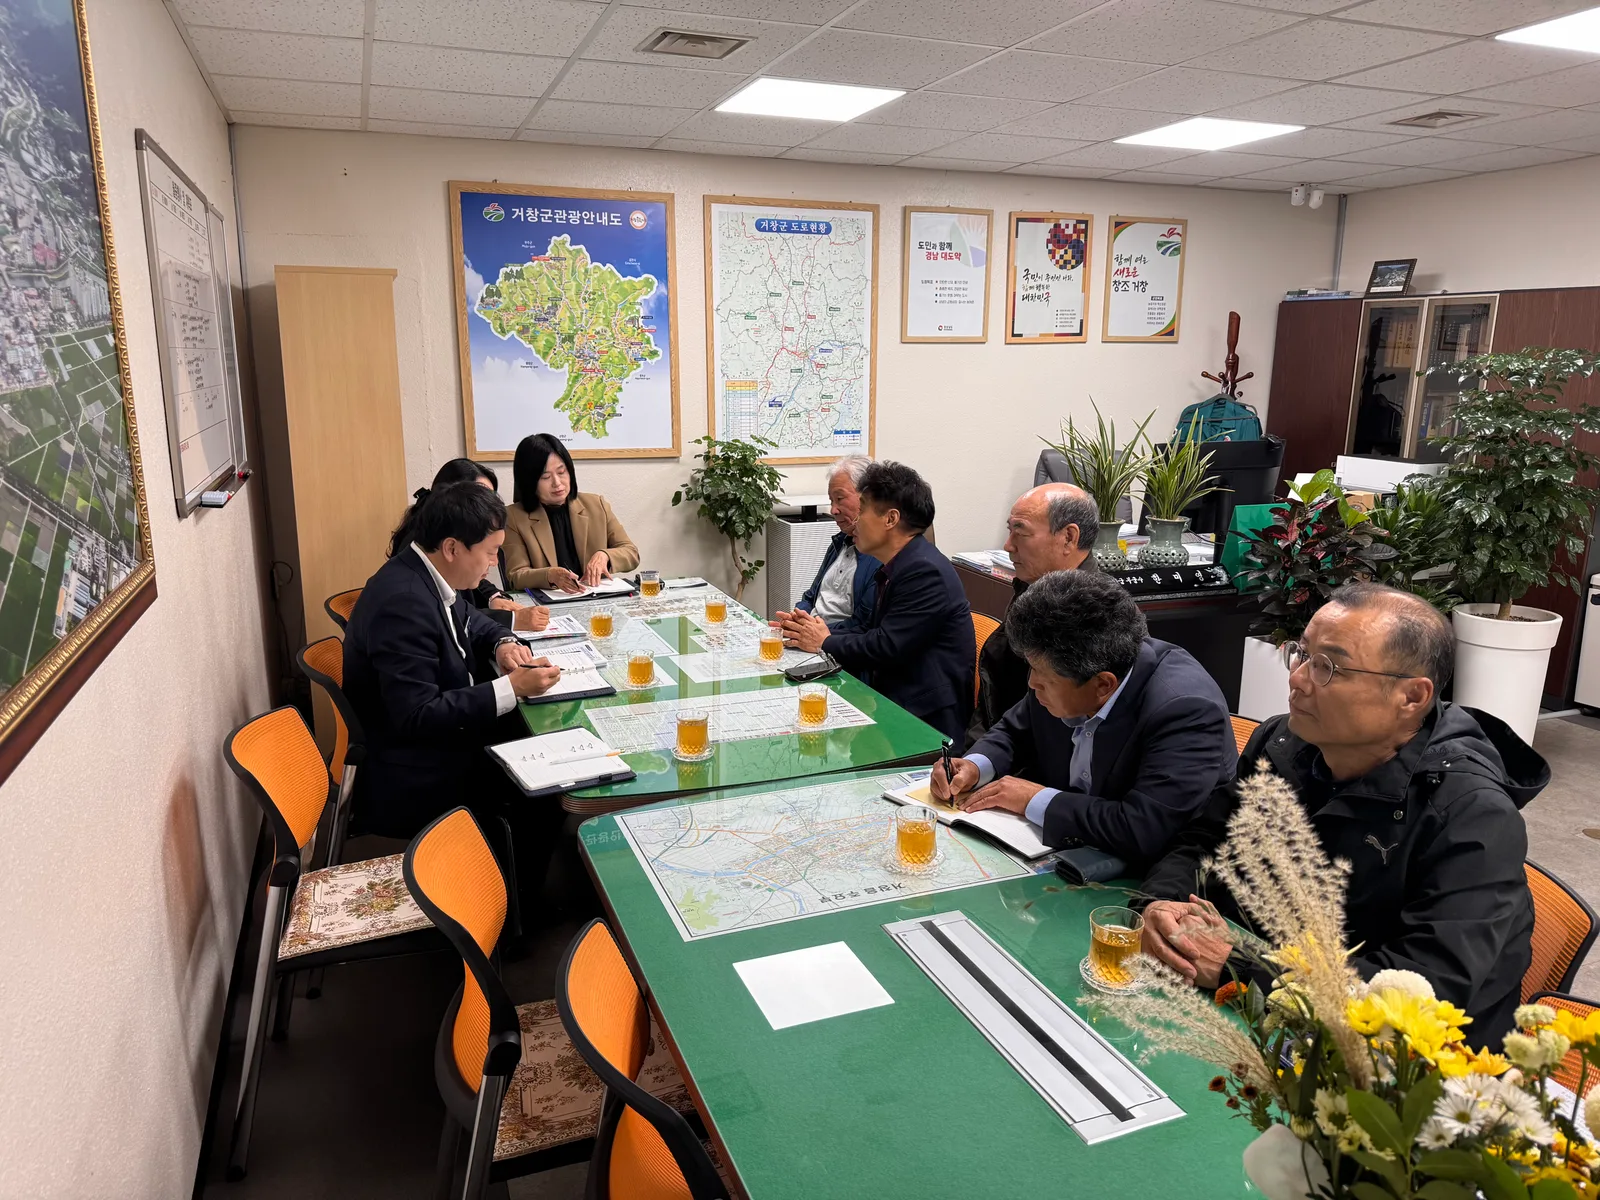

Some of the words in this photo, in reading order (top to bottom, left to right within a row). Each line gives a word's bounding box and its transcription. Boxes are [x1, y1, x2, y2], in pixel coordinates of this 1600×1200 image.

[511, 207, 623, 226] 거창군관광안내도
[760, 219, 788, 232] 거창군
[790, 221, 828, 234] 도로현황
[917, 241, 937, 251] 도민과
[938, 242, 953, 251] 함께
[925, 251, 939, 261] 경남
[940, 252, 962, 262] 대도약
[1114, 254, 1132, 266] 함께
[1022, 268, 1043, 284] 국민이
[1044, 273, 1062, 282] 주인인
[1113, 267, 1140, 278] 새로운
[1112, 280, 1130, 293] 창조
[1132, 280, 1149, 293] 거창
[1021, 291, 1052, 308] 대한민국
[864, 881, 906, 896] 거창읍
[817, 888, 862, 905] 주요부
